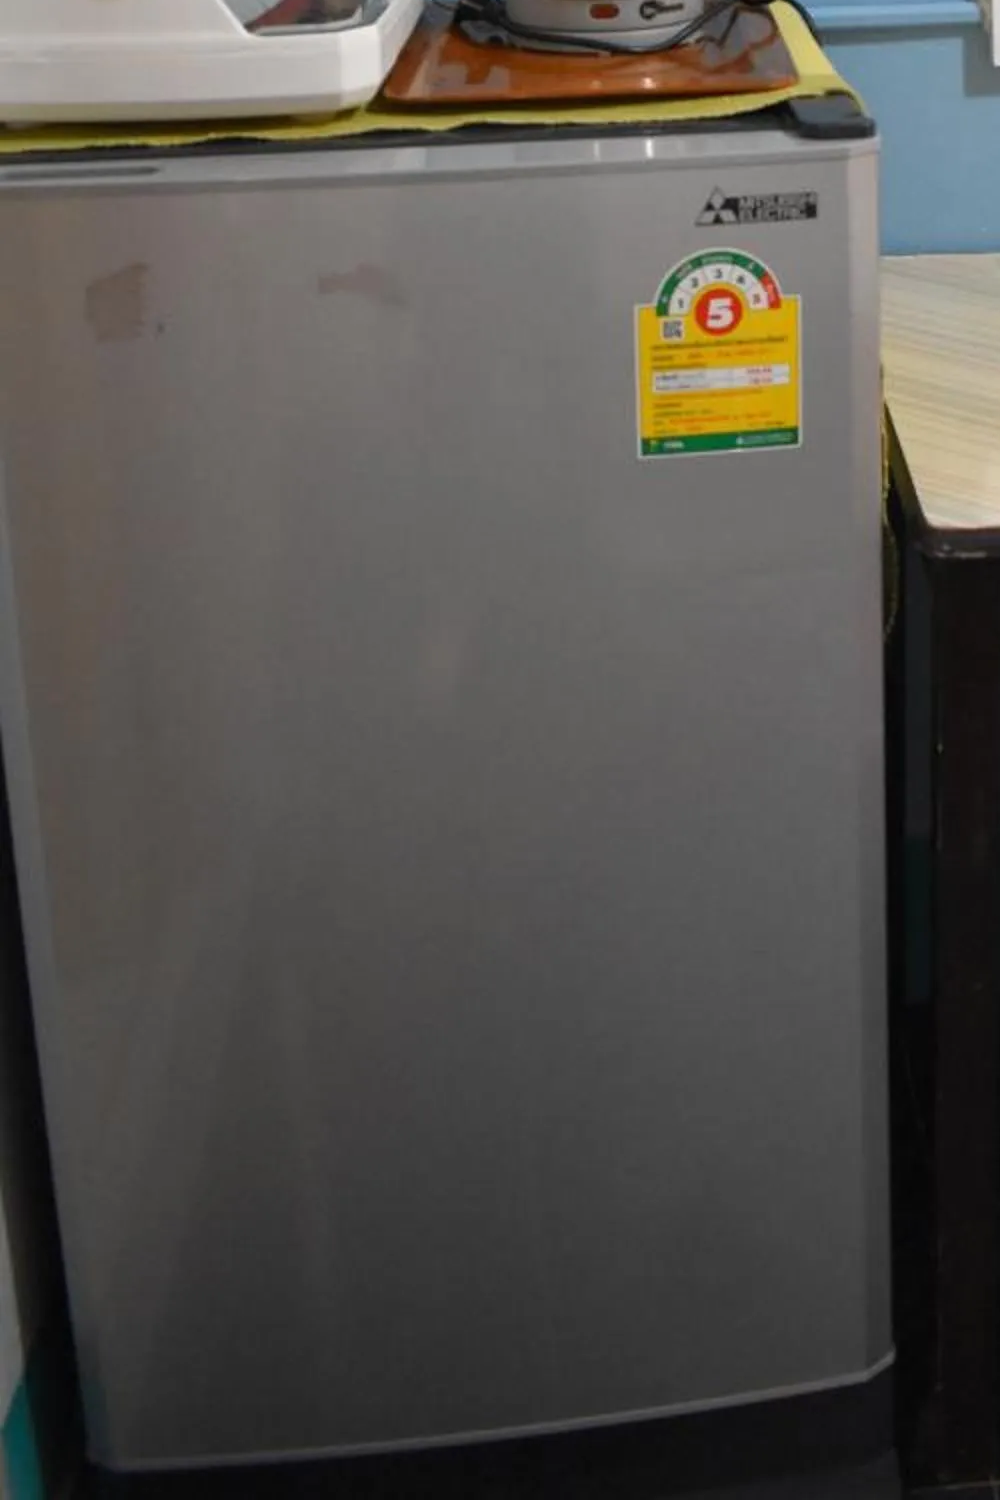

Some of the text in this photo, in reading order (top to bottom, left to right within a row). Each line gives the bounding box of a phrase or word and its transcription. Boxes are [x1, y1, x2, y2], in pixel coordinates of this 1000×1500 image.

[739, 204, 806, 221] ELECTRIC
[714, 267, 723, 279] 3
[706, 297, 735, 329] 5
